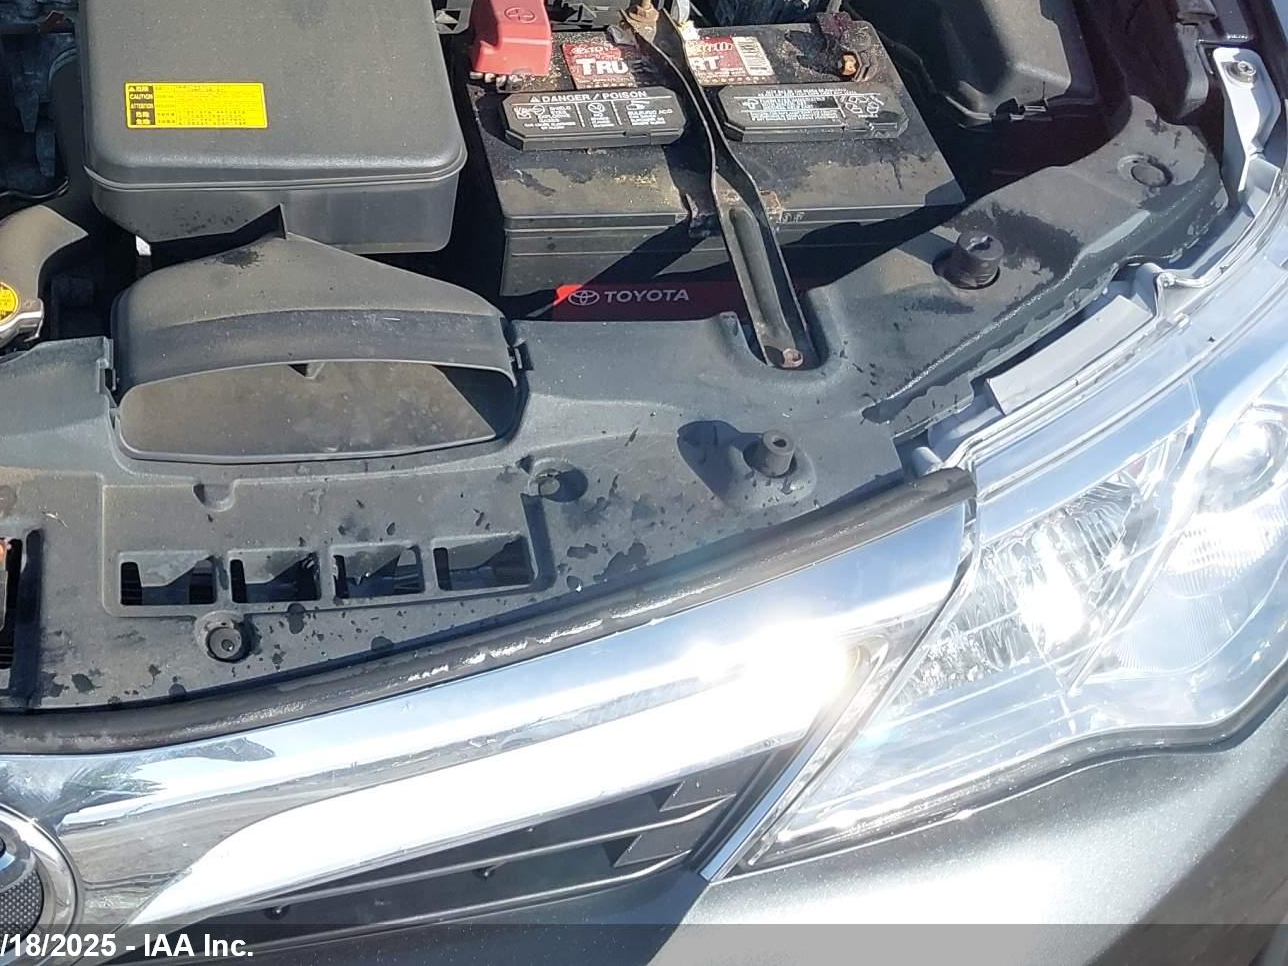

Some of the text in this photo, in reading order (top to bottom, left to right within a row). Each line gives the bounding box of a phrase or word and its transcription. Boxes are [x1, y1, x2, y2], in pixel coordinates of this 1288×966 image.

[542, 94, 591, 103] DANGER
[602, 91, 647, 100] POISON
[604, 289, 690, 303] TOYOTA
